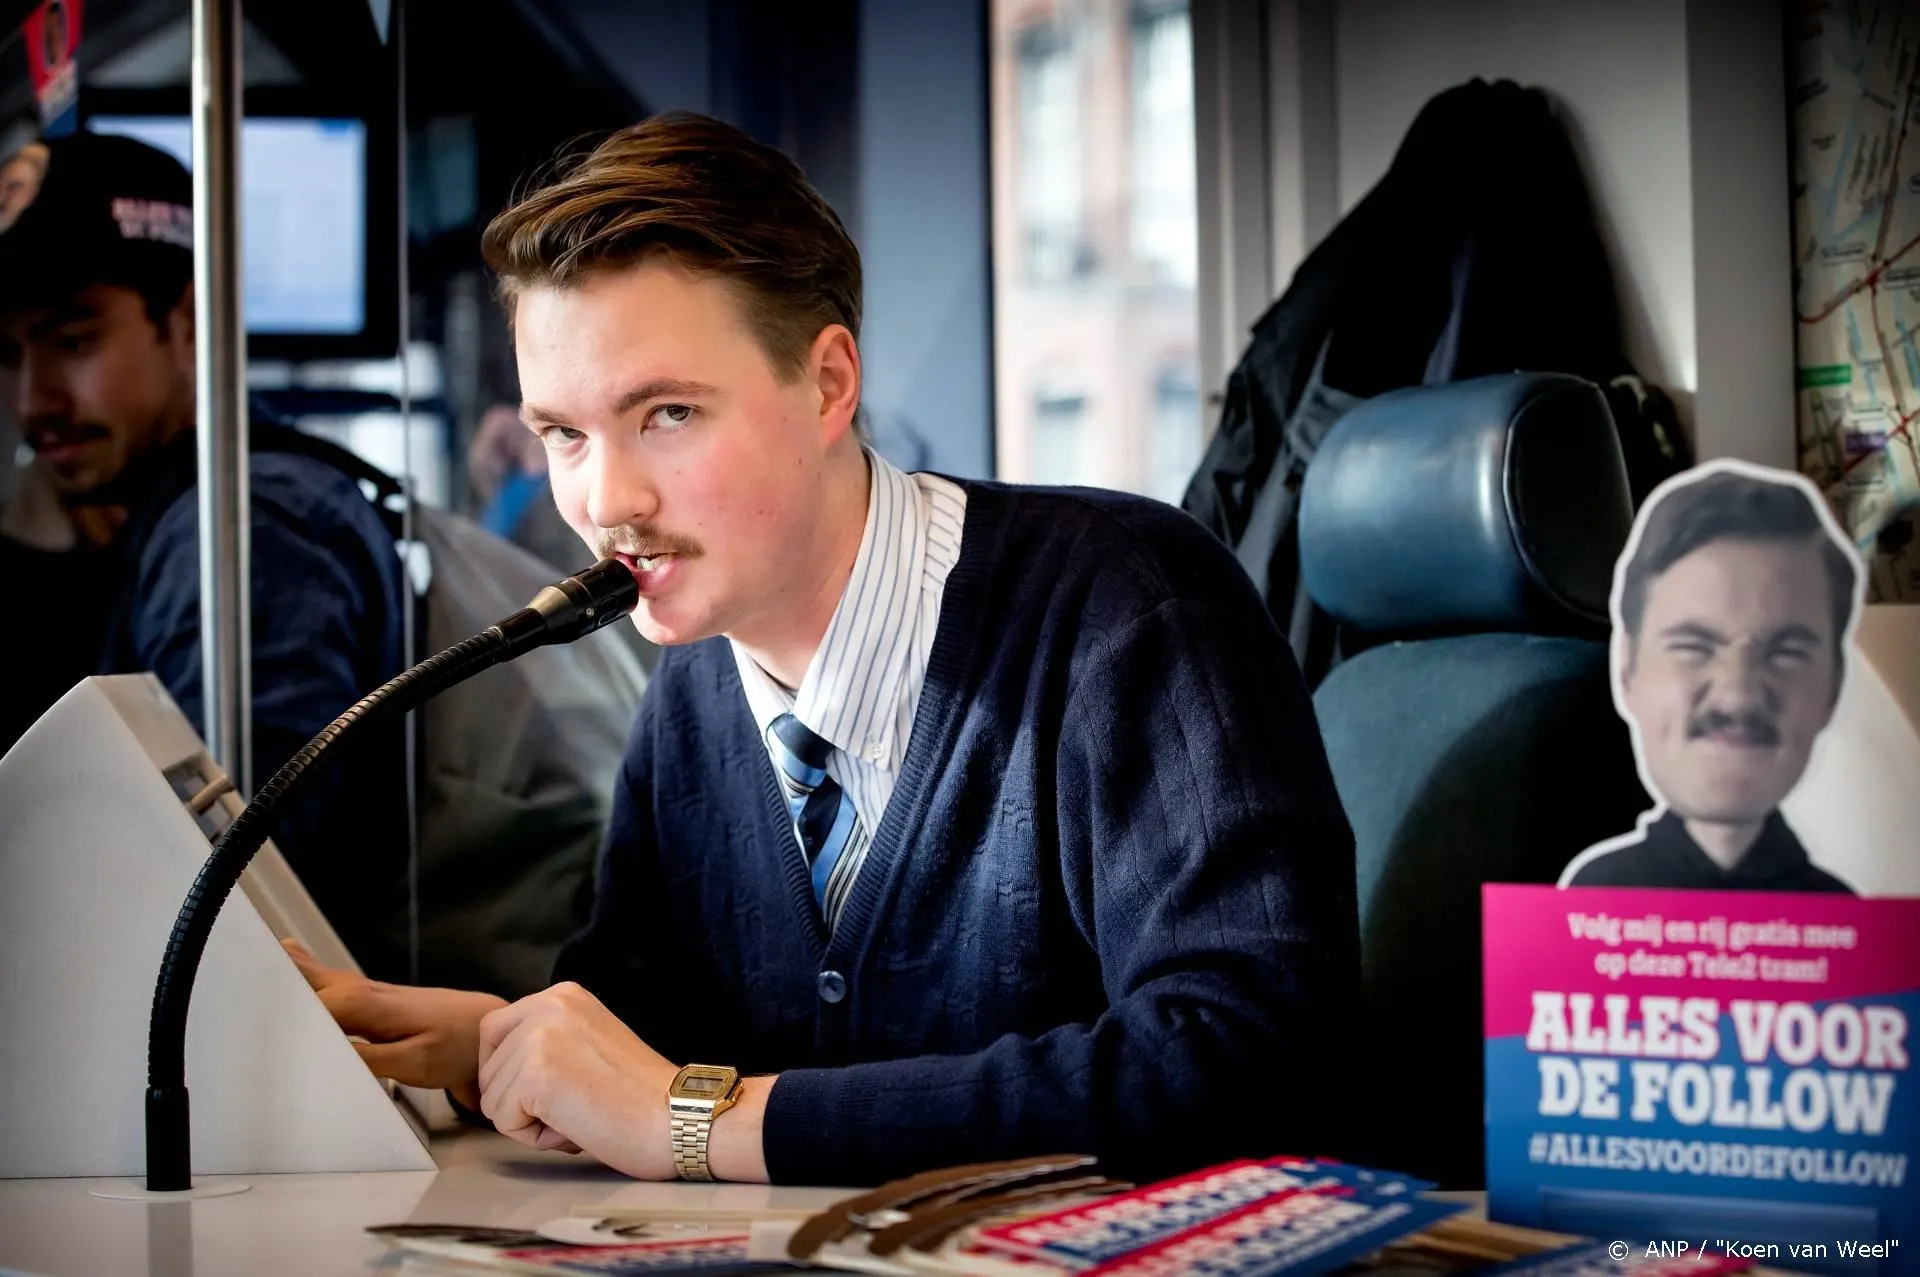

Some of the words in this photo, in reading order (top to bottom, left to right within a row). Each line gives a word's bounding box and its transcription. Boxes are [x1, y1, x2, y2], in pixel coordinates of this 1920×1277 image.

[1568, 912, 1621, 946] Volg
[1624, 914, 1662, 948] mij
[1665, 920, 1696, 943] en
[1698, 916, 1726, 949] rij
[1729, 918, 1799, 950] gratis
[1803, 925, 1857, 949] mee
[1595, 953, 1625, 980] op
[1628, 949, 1686, 977] deze
[1688, 951, 1757, 980] Tele2
[1759, 954, 1828, 983] tram!
[1526, 991, 1720, 1060] ALLES
[1729, 1000, 1909, 1069] VOOR
[1538, 1058, 1619, 1119] DE
[1631, 1062, 1895, 1134] FOLLOW
[1528, 1132, 1907, 1187] #ALLESVOORDEFOLLOW
